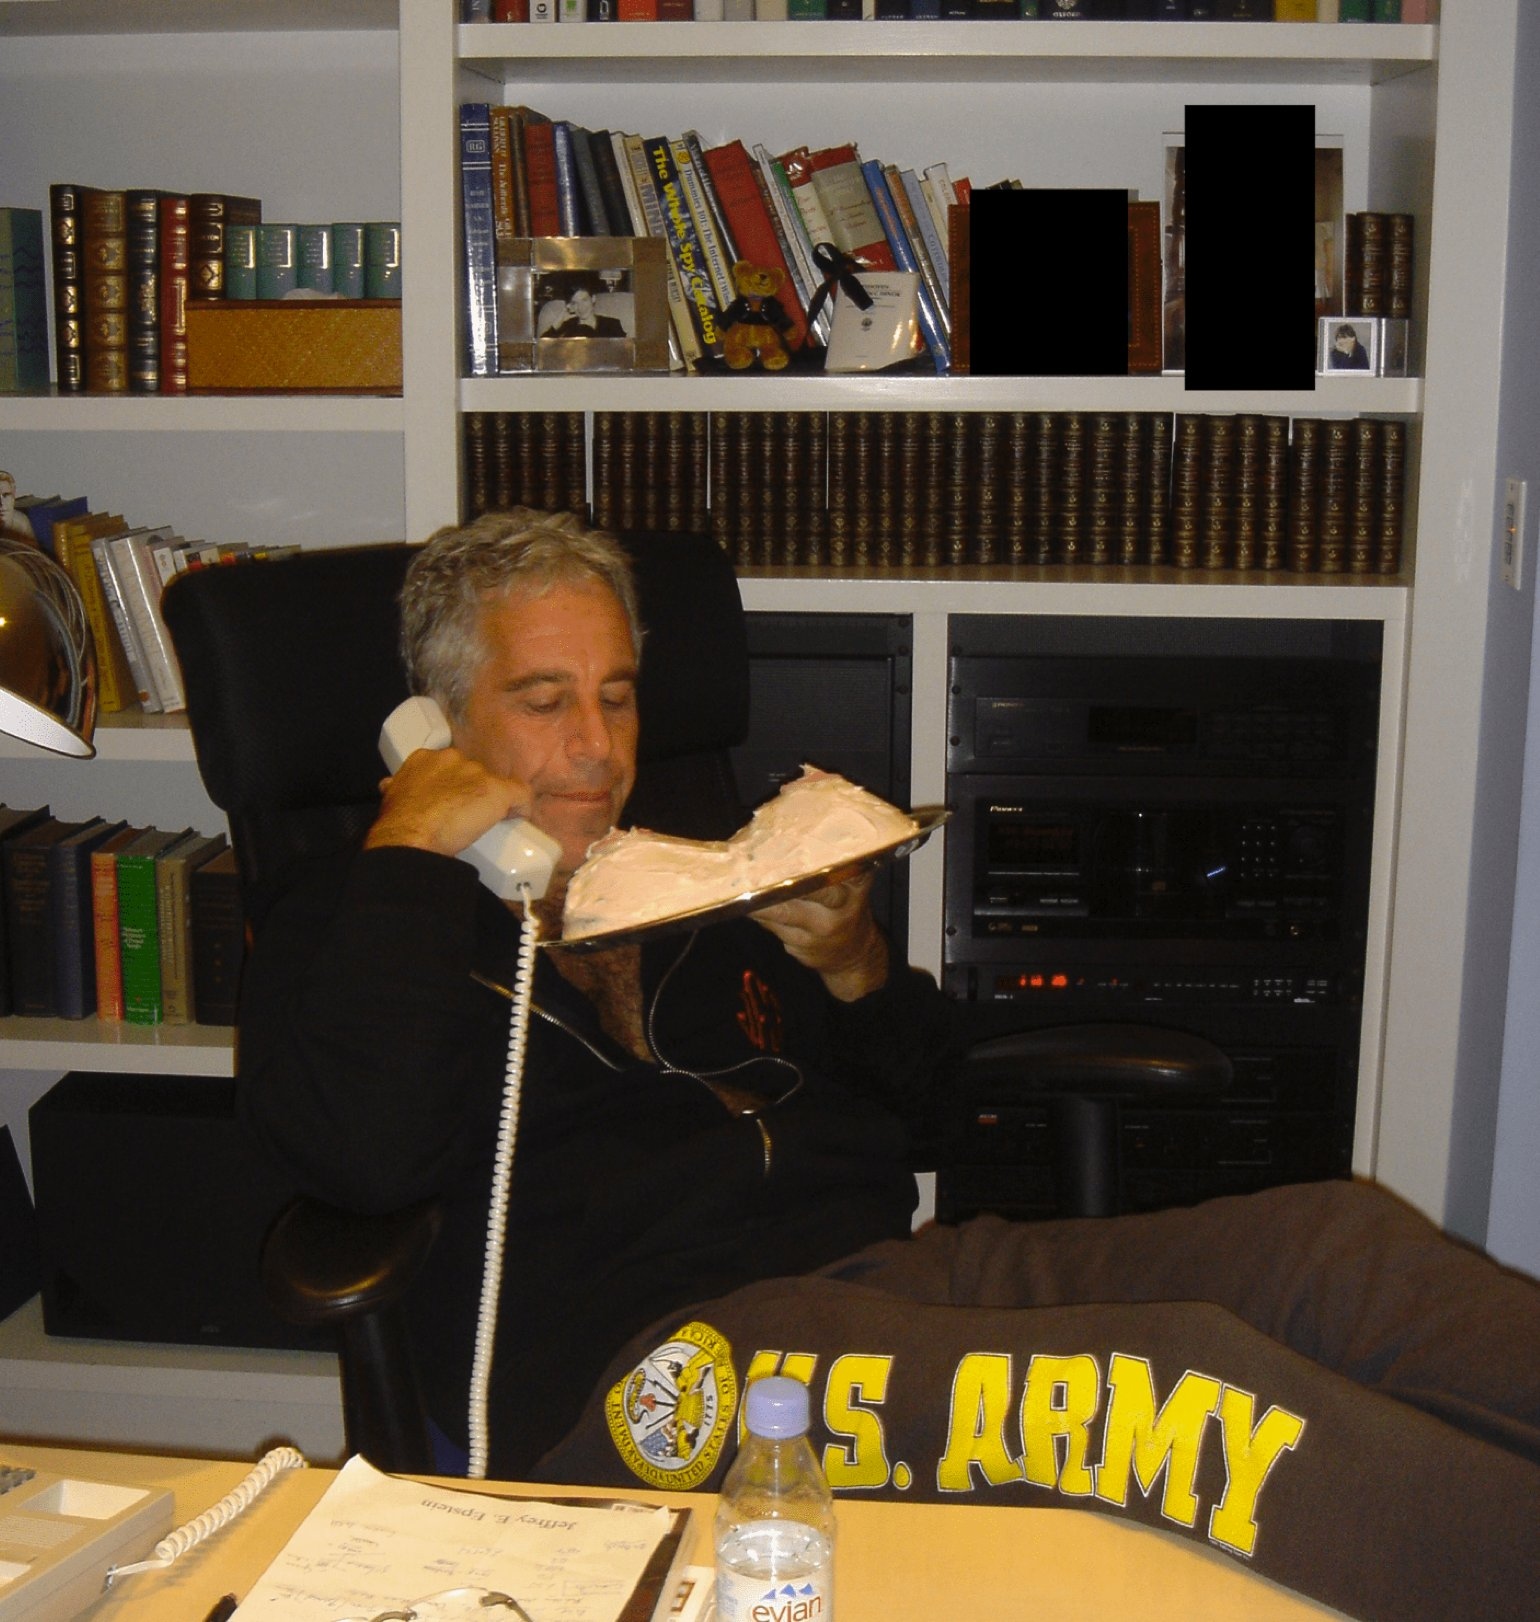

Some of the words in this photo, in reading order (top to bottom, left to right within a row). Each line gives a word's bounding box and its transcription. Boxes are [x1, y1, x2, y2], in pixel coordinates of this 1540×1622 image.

[684, 169, 700, 208] Dummies
[652, 145, 669, 180] The
[663, 181, 688, 240] Whole
[680, 242, 697, 273] Spy
[691, 276, 717, 344] Catalog
[703, 228, 715, 243] The
[708, 244, 727, 281] Internet
[704, 1395, 714, 1427] 1775
[667, 1460, 705, 1485] UNITED
[703, 1404, 730, 1461] STATES
[719, 1376, 729, 1395] OF
[938, 1352, 1305, 1556] ARMY
[420, 1499, 487, 1522] Epstein
[494, 1513, 512, 1525] E.
[517, 1514, 578, 1531] Jeffrey
[752, 1596, 822, 1622] evian
